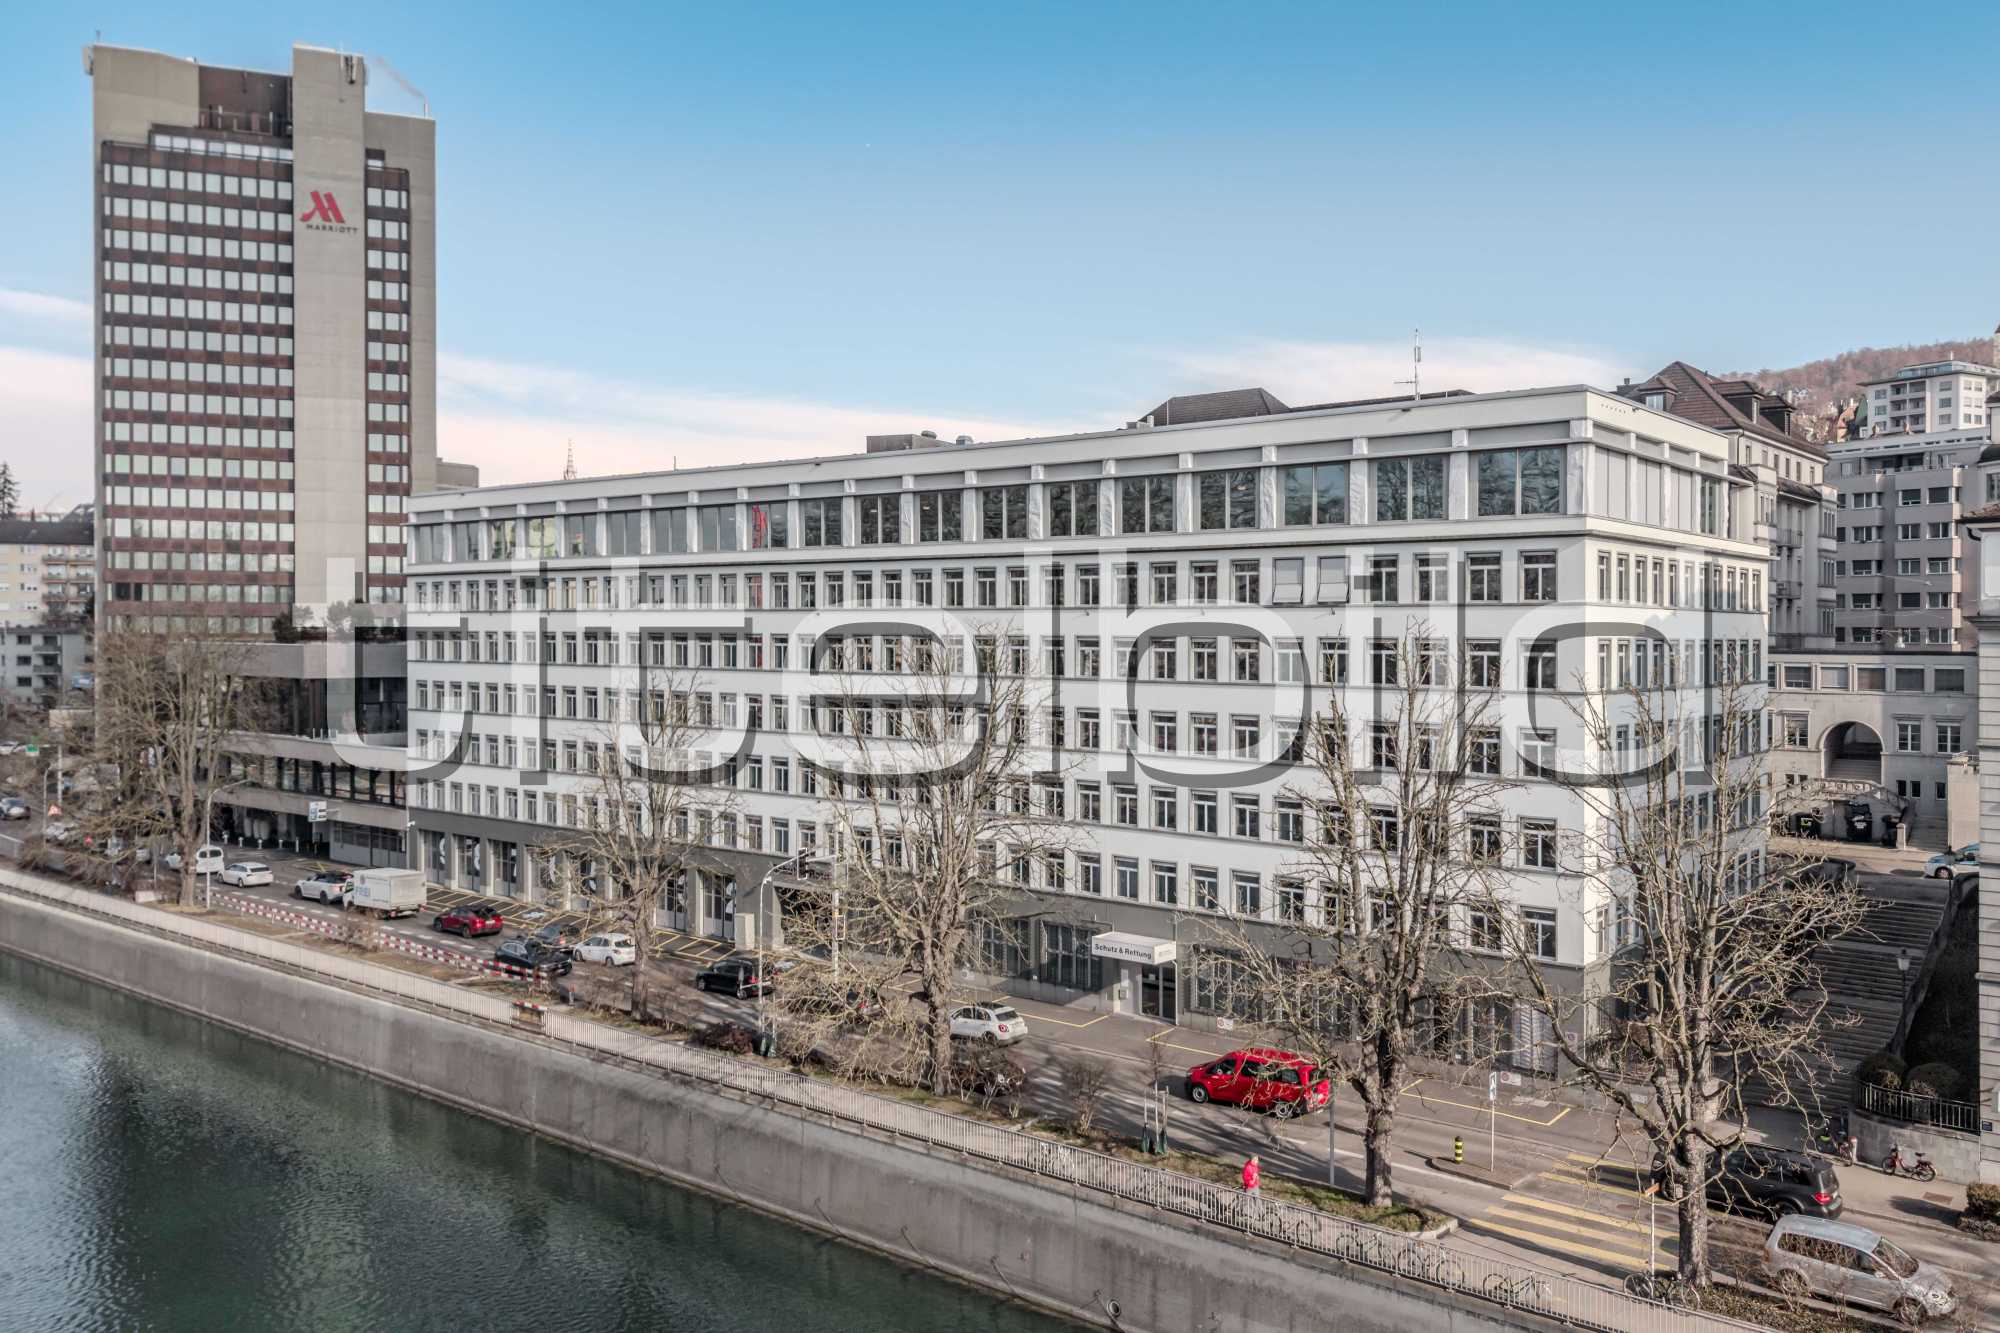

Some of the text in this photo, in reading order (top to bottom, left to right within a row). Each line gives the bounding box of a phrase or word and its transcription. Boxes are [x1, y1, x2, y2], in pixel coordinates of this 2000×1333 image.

[305, 223, 359, 234] MARRIOTT
[1094, 943, 1118, 953] Schutz
[1124, 947, 1152, 960] Rettung
